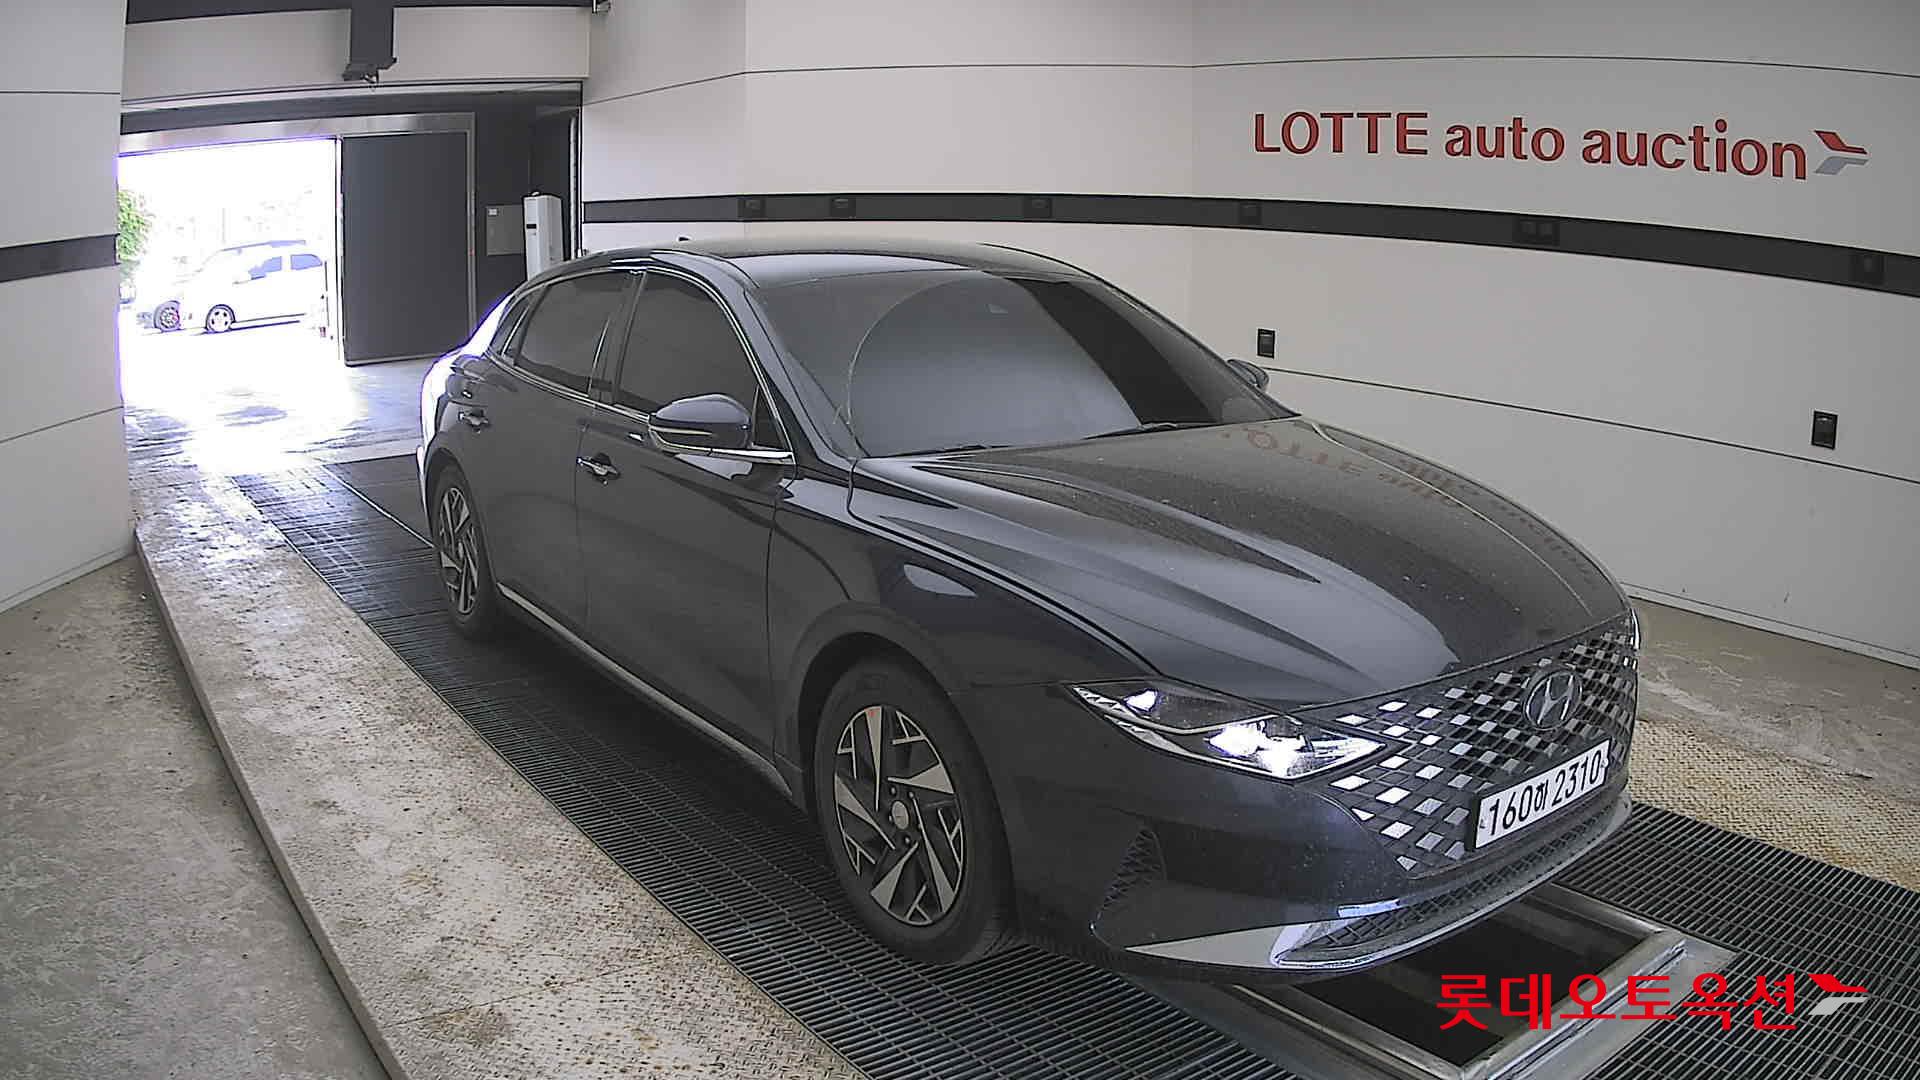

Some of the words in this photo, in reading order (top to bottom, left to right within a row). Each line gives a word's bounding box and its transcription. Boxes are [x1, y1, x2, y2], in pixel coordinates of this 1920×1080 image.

[1253, 111, 1428, 156] LOTTE
[1445, 117, 1565, 162] auto
[1582, 118, 1807, 180] auction
[1551, 750, 1602, 807] 2310
